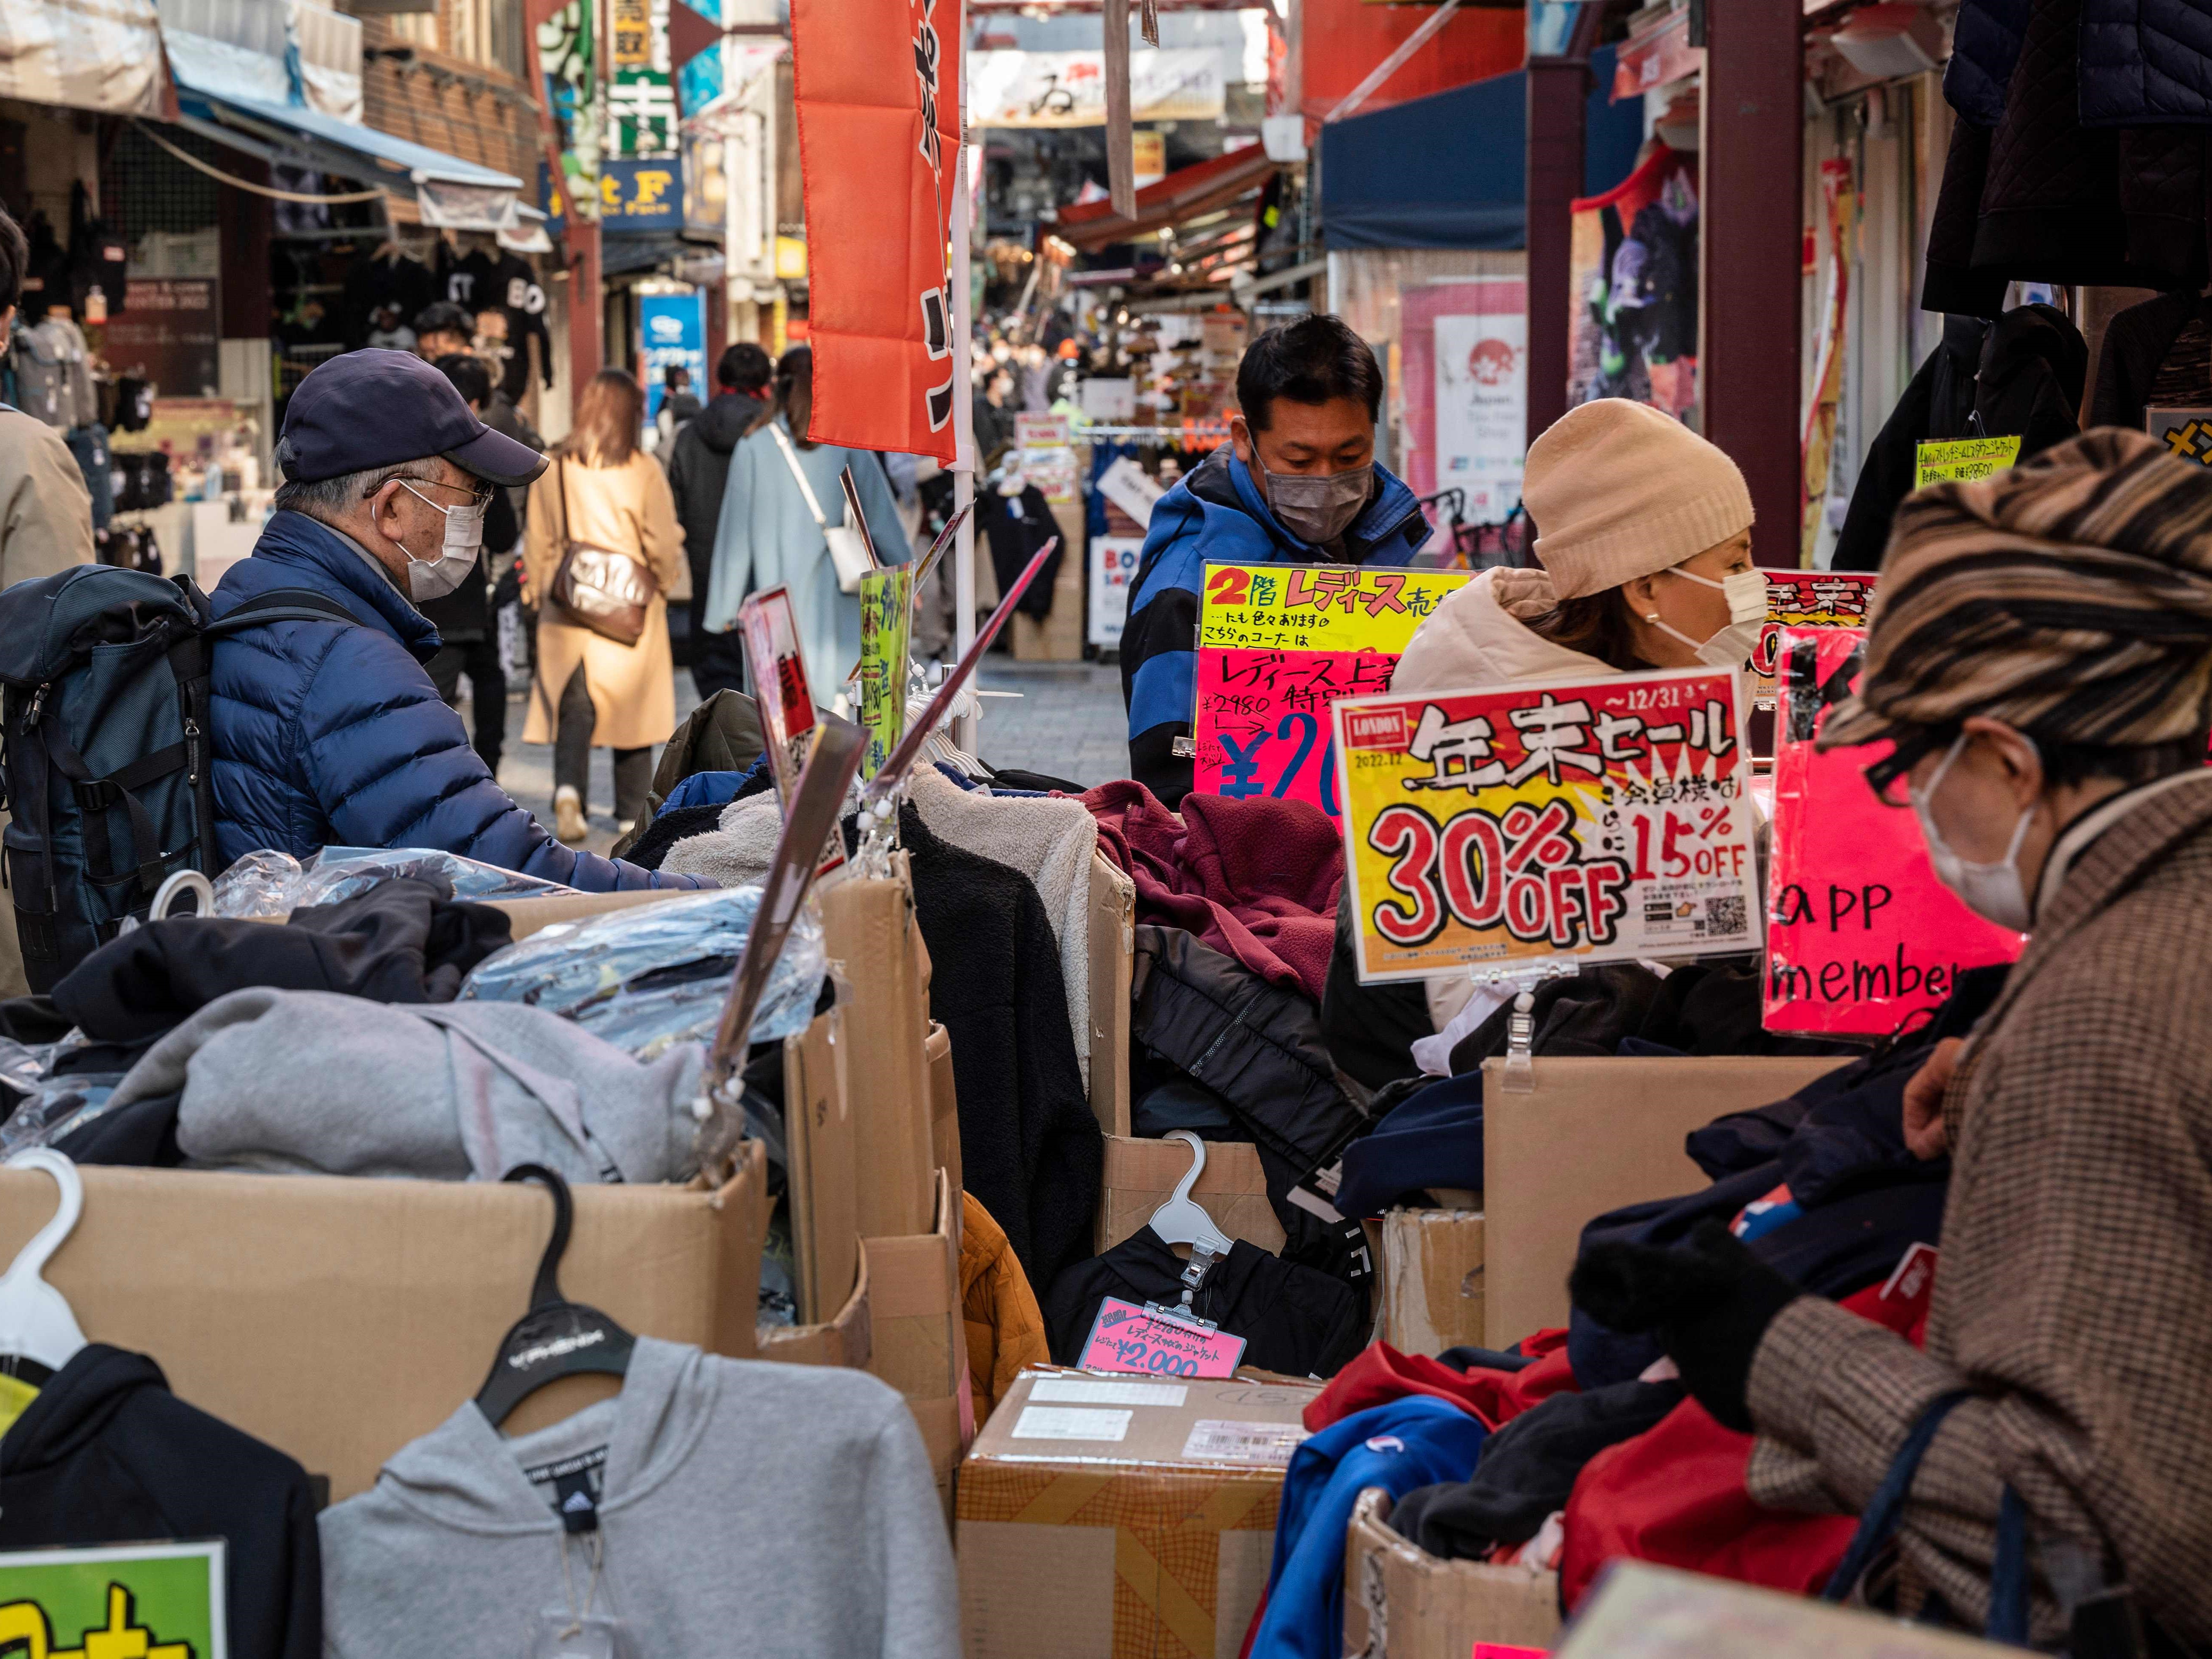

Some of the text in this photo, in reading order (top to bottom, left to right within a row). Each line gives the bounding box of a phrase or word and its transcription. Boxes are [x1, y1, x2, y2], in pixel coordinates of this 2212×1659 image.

[1353, 716, 1400, 738] LONDON
[1694, 844, 1746, 878] OFF
[1777, 883, 1893, 932] app
